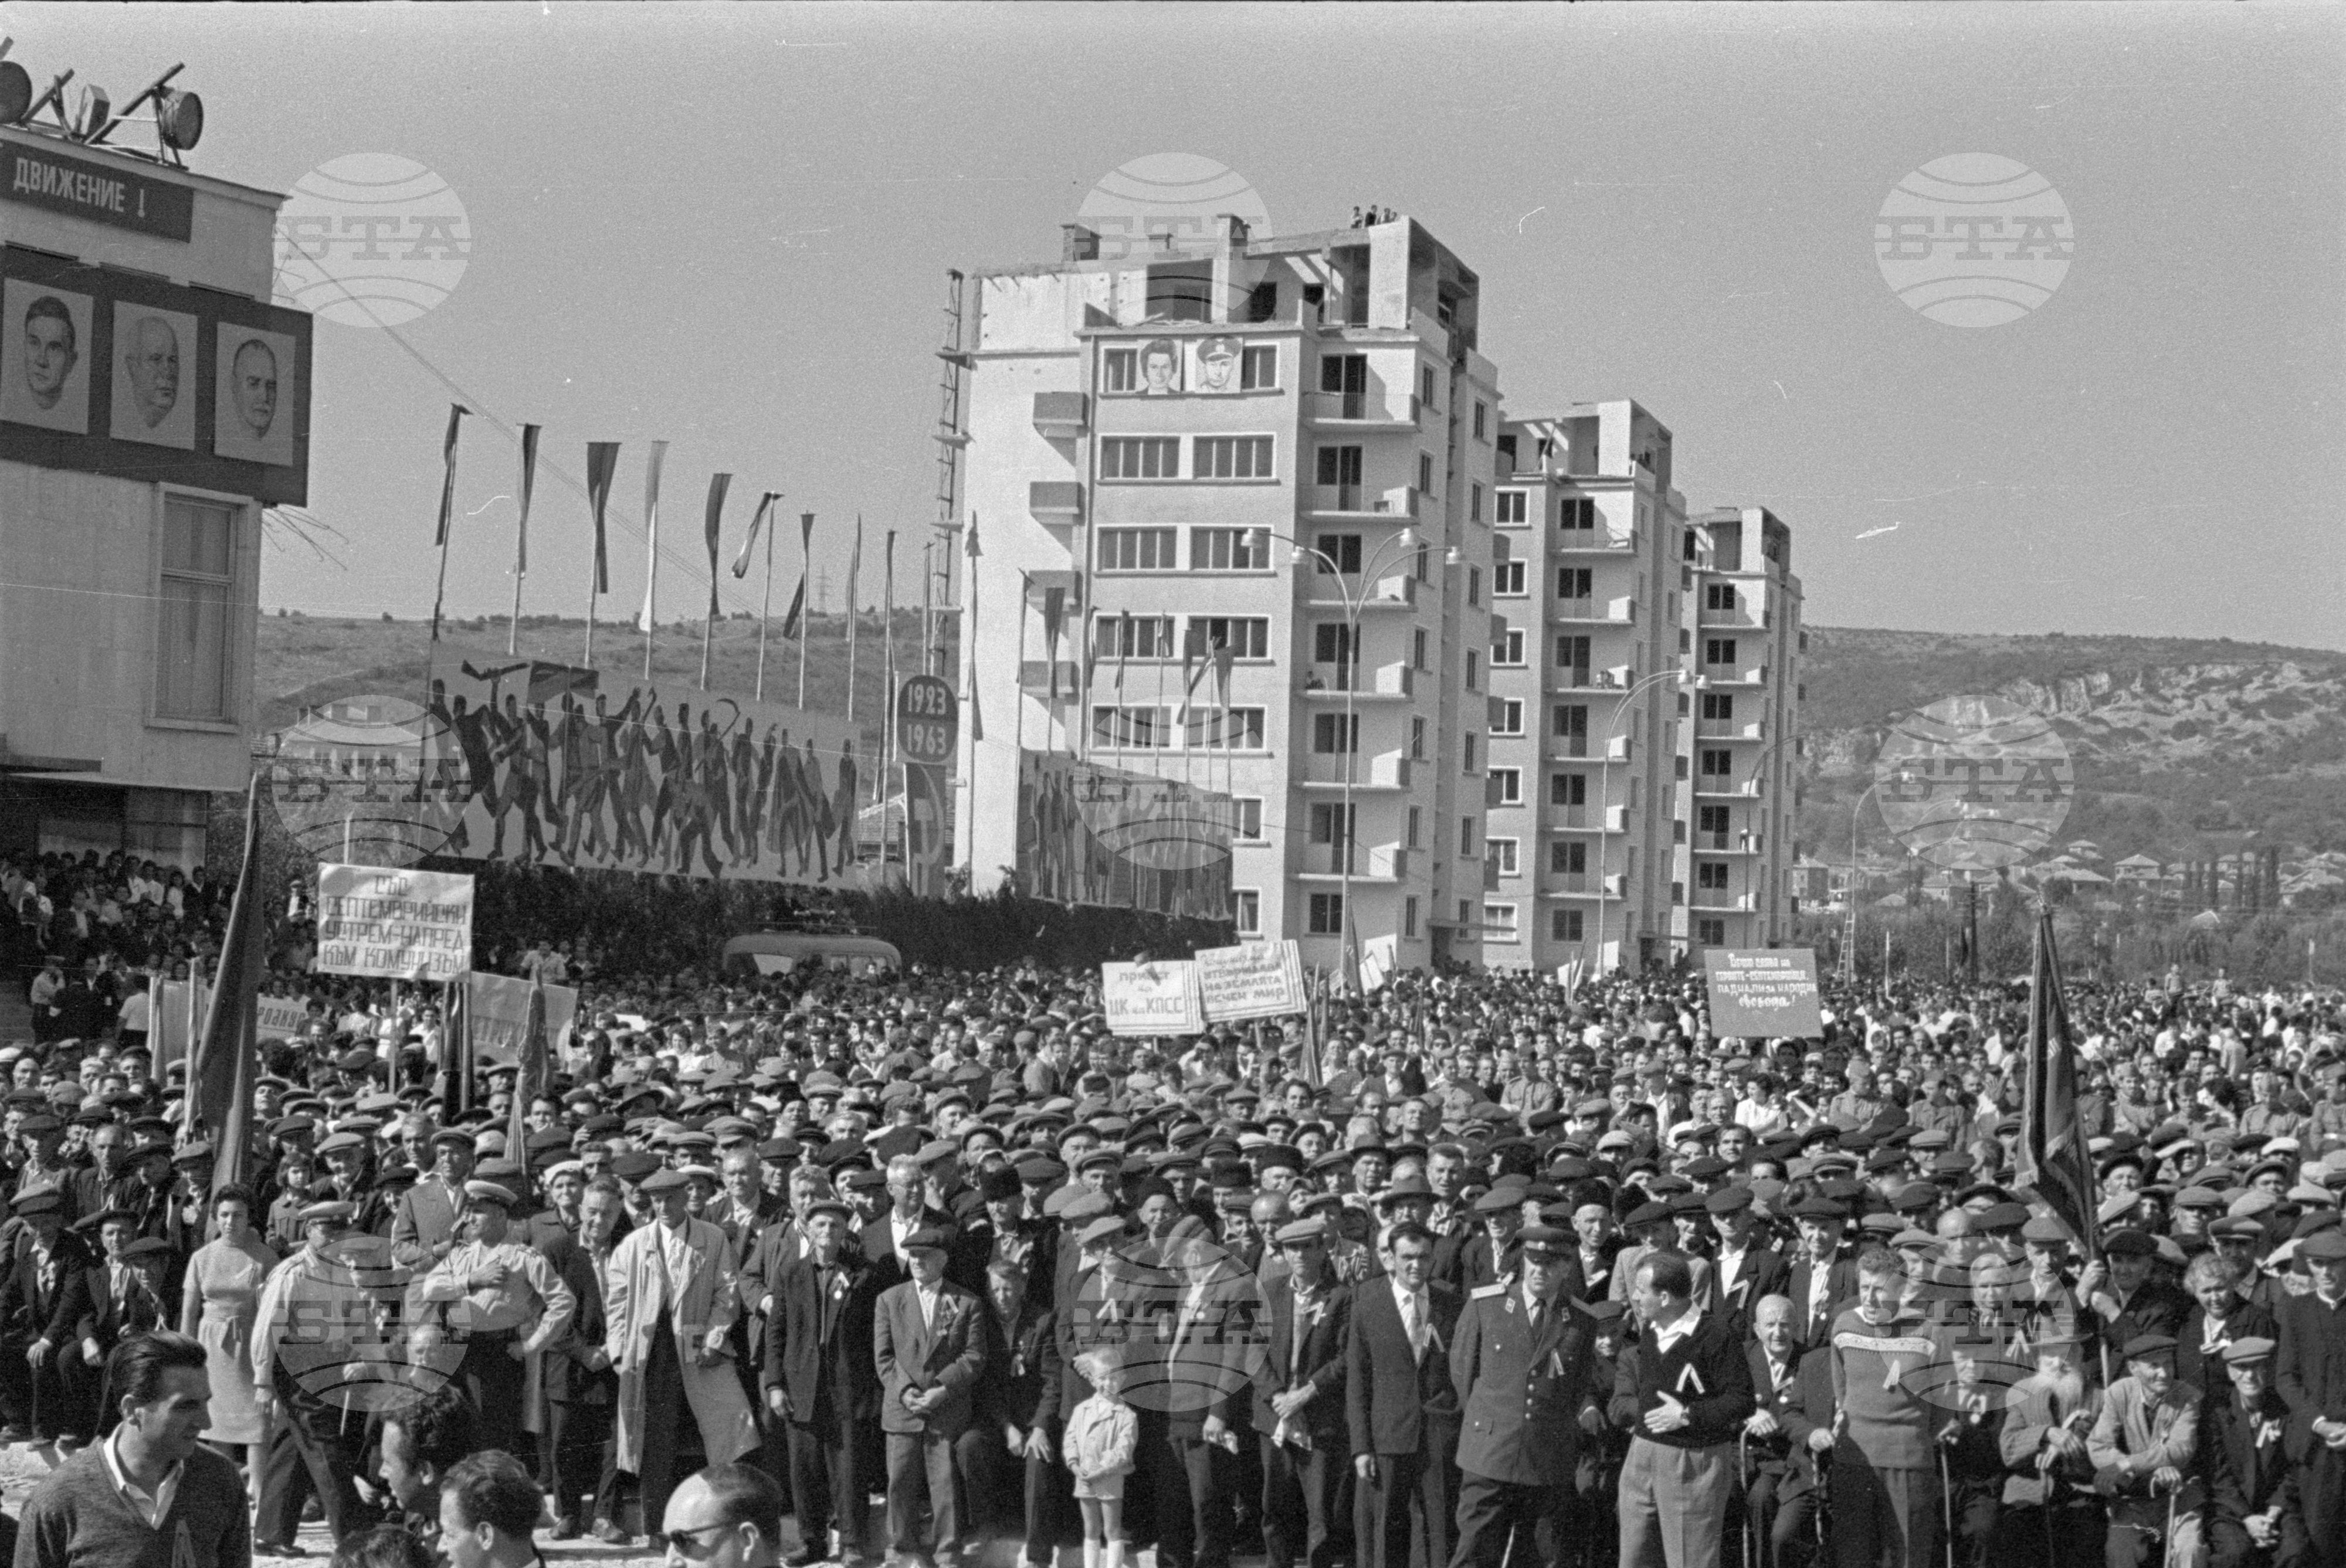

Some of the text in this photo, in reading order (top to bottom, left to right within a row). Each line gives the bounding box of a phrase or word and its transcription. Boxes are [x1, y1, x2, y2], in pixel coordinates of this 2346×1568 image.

[13, 157, 126, 213] ДВИЖЕНИЕ
[907, 684, 947, 715] 1923
[906, 724, 947, 755] 1963
[374, 875, 408, 897] СЪС
[326, 895, 467, 926] СЕПТЕМВРИЙСКИ
[323, 944, 465, 975] КЪМ КОМУНИЗЪМ
[1109, 997, 1129, 1017] ЦК
[1146, 996, 1184, 1014] КПСС
